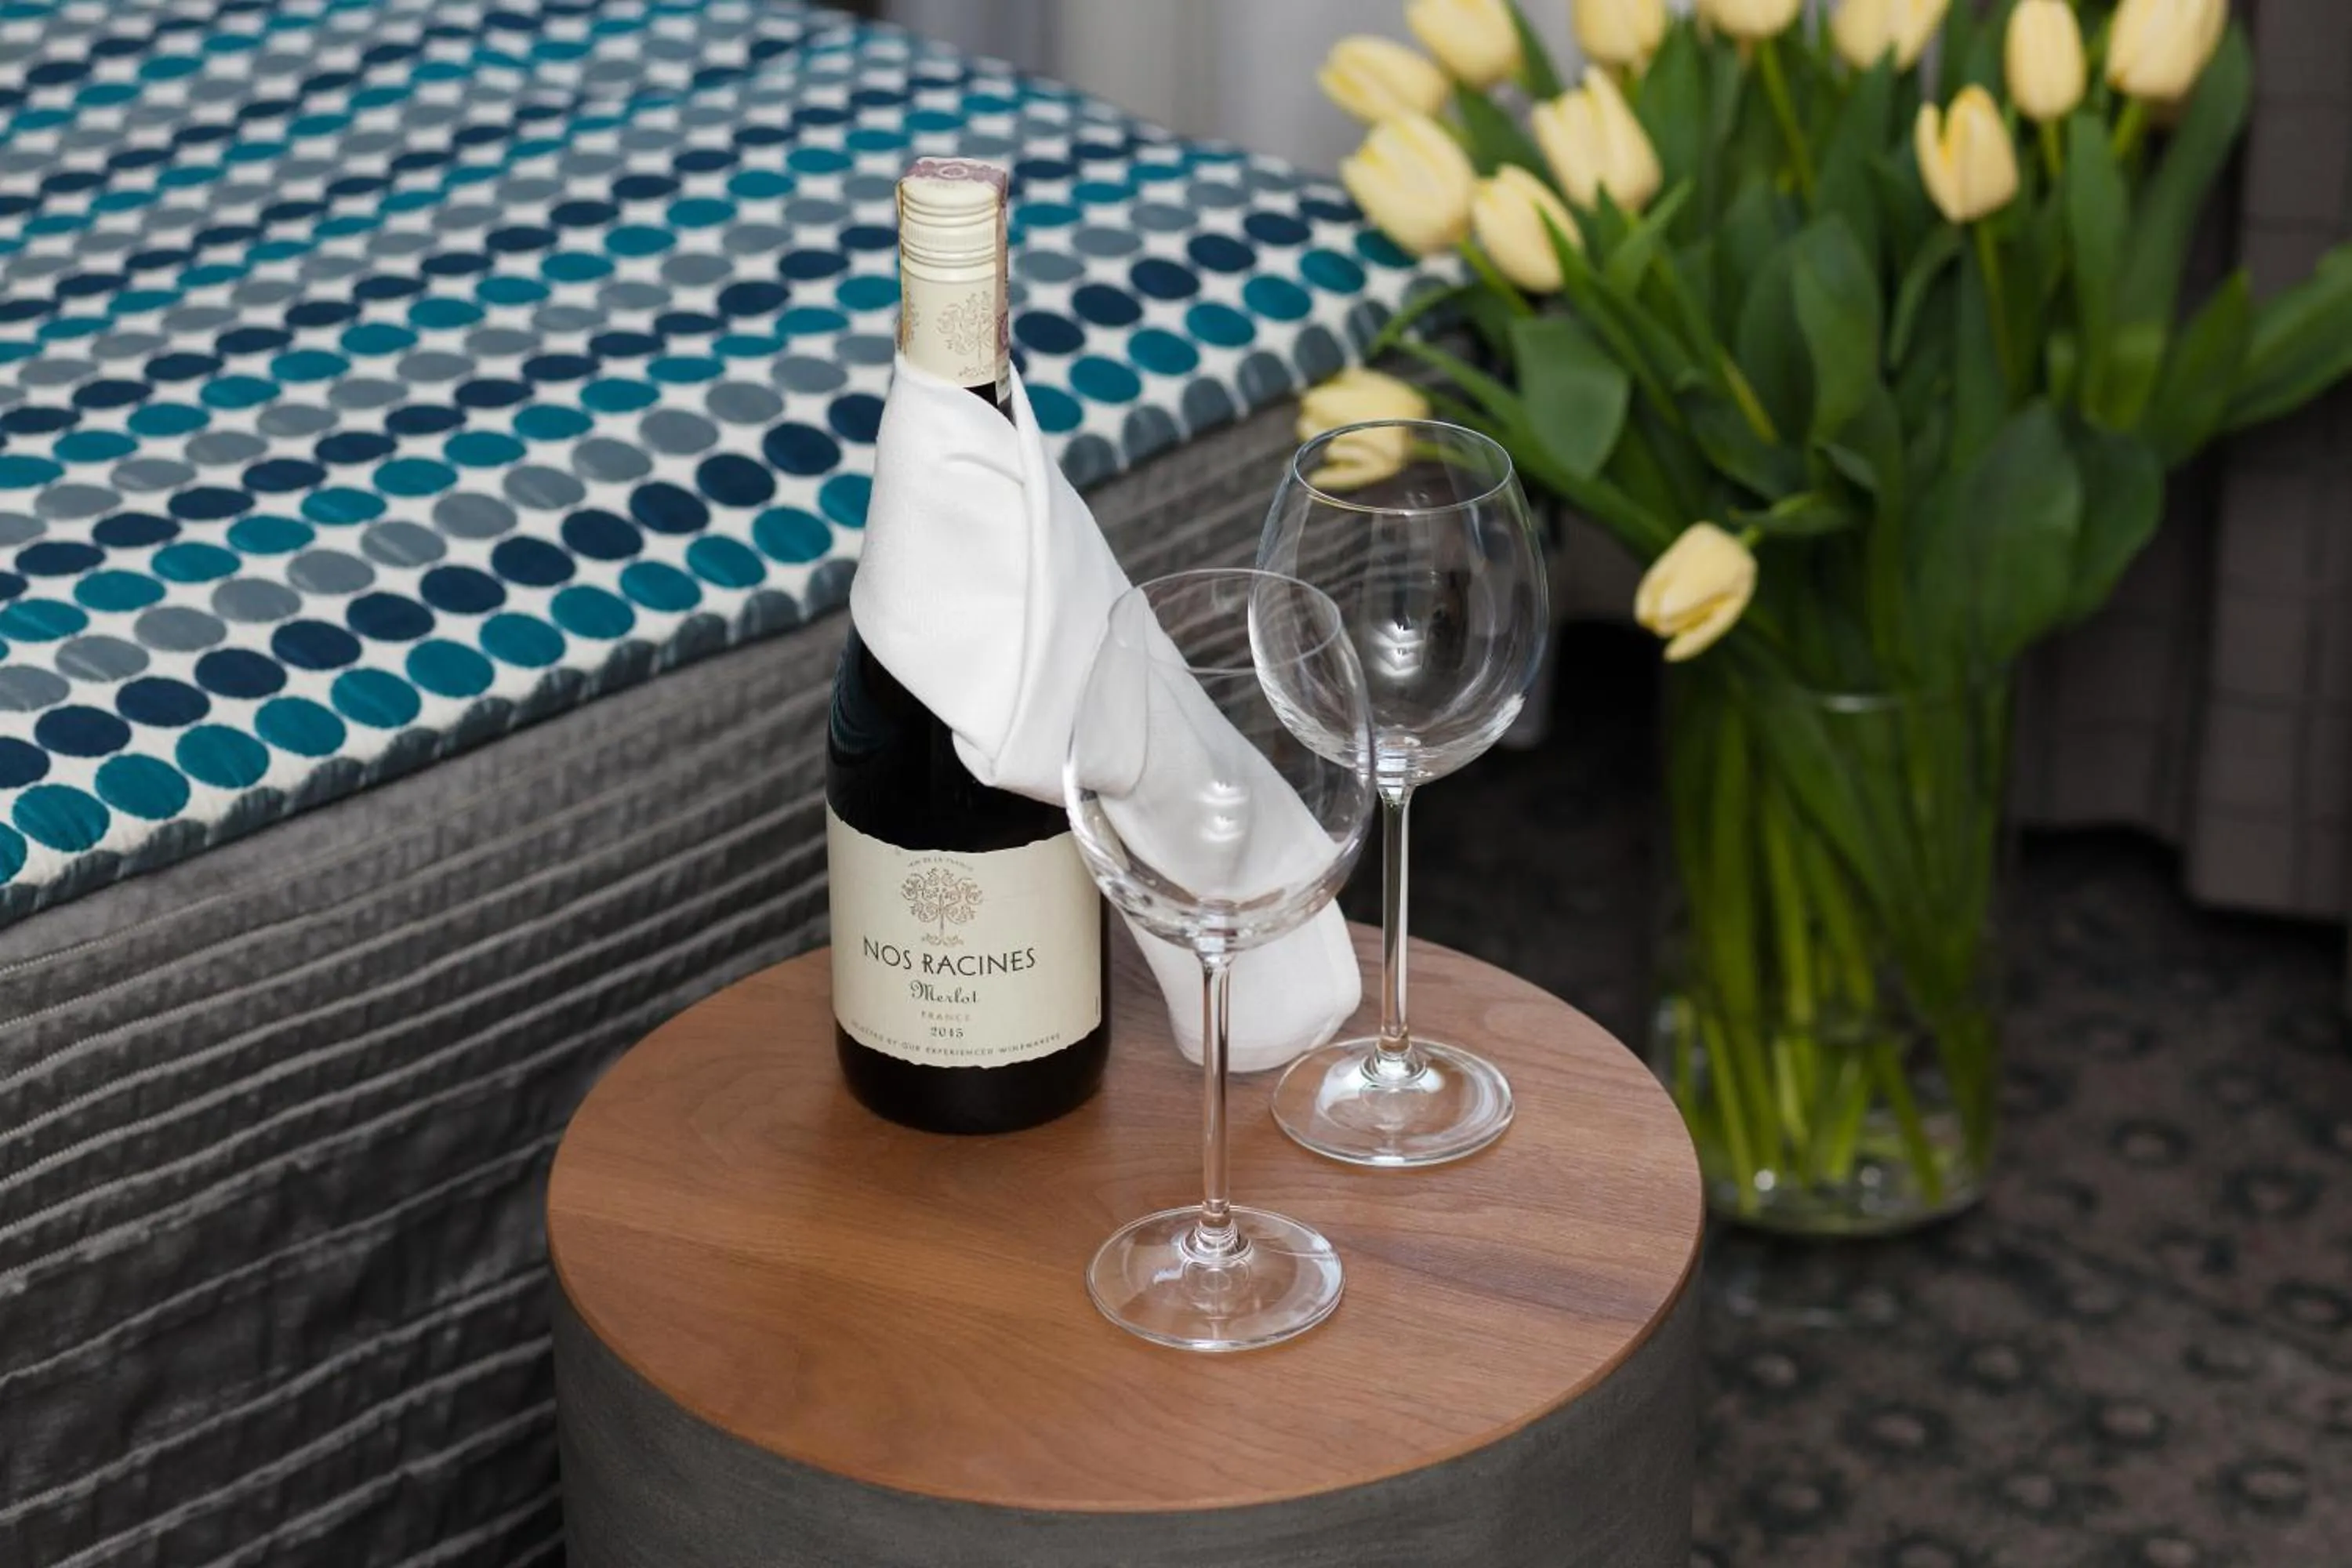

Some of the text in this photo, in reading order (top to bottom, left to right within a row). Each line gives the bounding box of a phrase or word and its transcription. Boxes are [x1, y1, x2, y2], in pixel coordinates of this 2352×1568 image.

[863, 935, 1036, 976] NOS RACINES
[909, 979, 977, 1004] Merlot
[920, 1009, 971, 1022] FRANCE
[930, 1026, 964, 1038] 2015
[901, 1040, 920, 1052] OUR
[925, 1046, 994, 1056] EXPERIENCED
